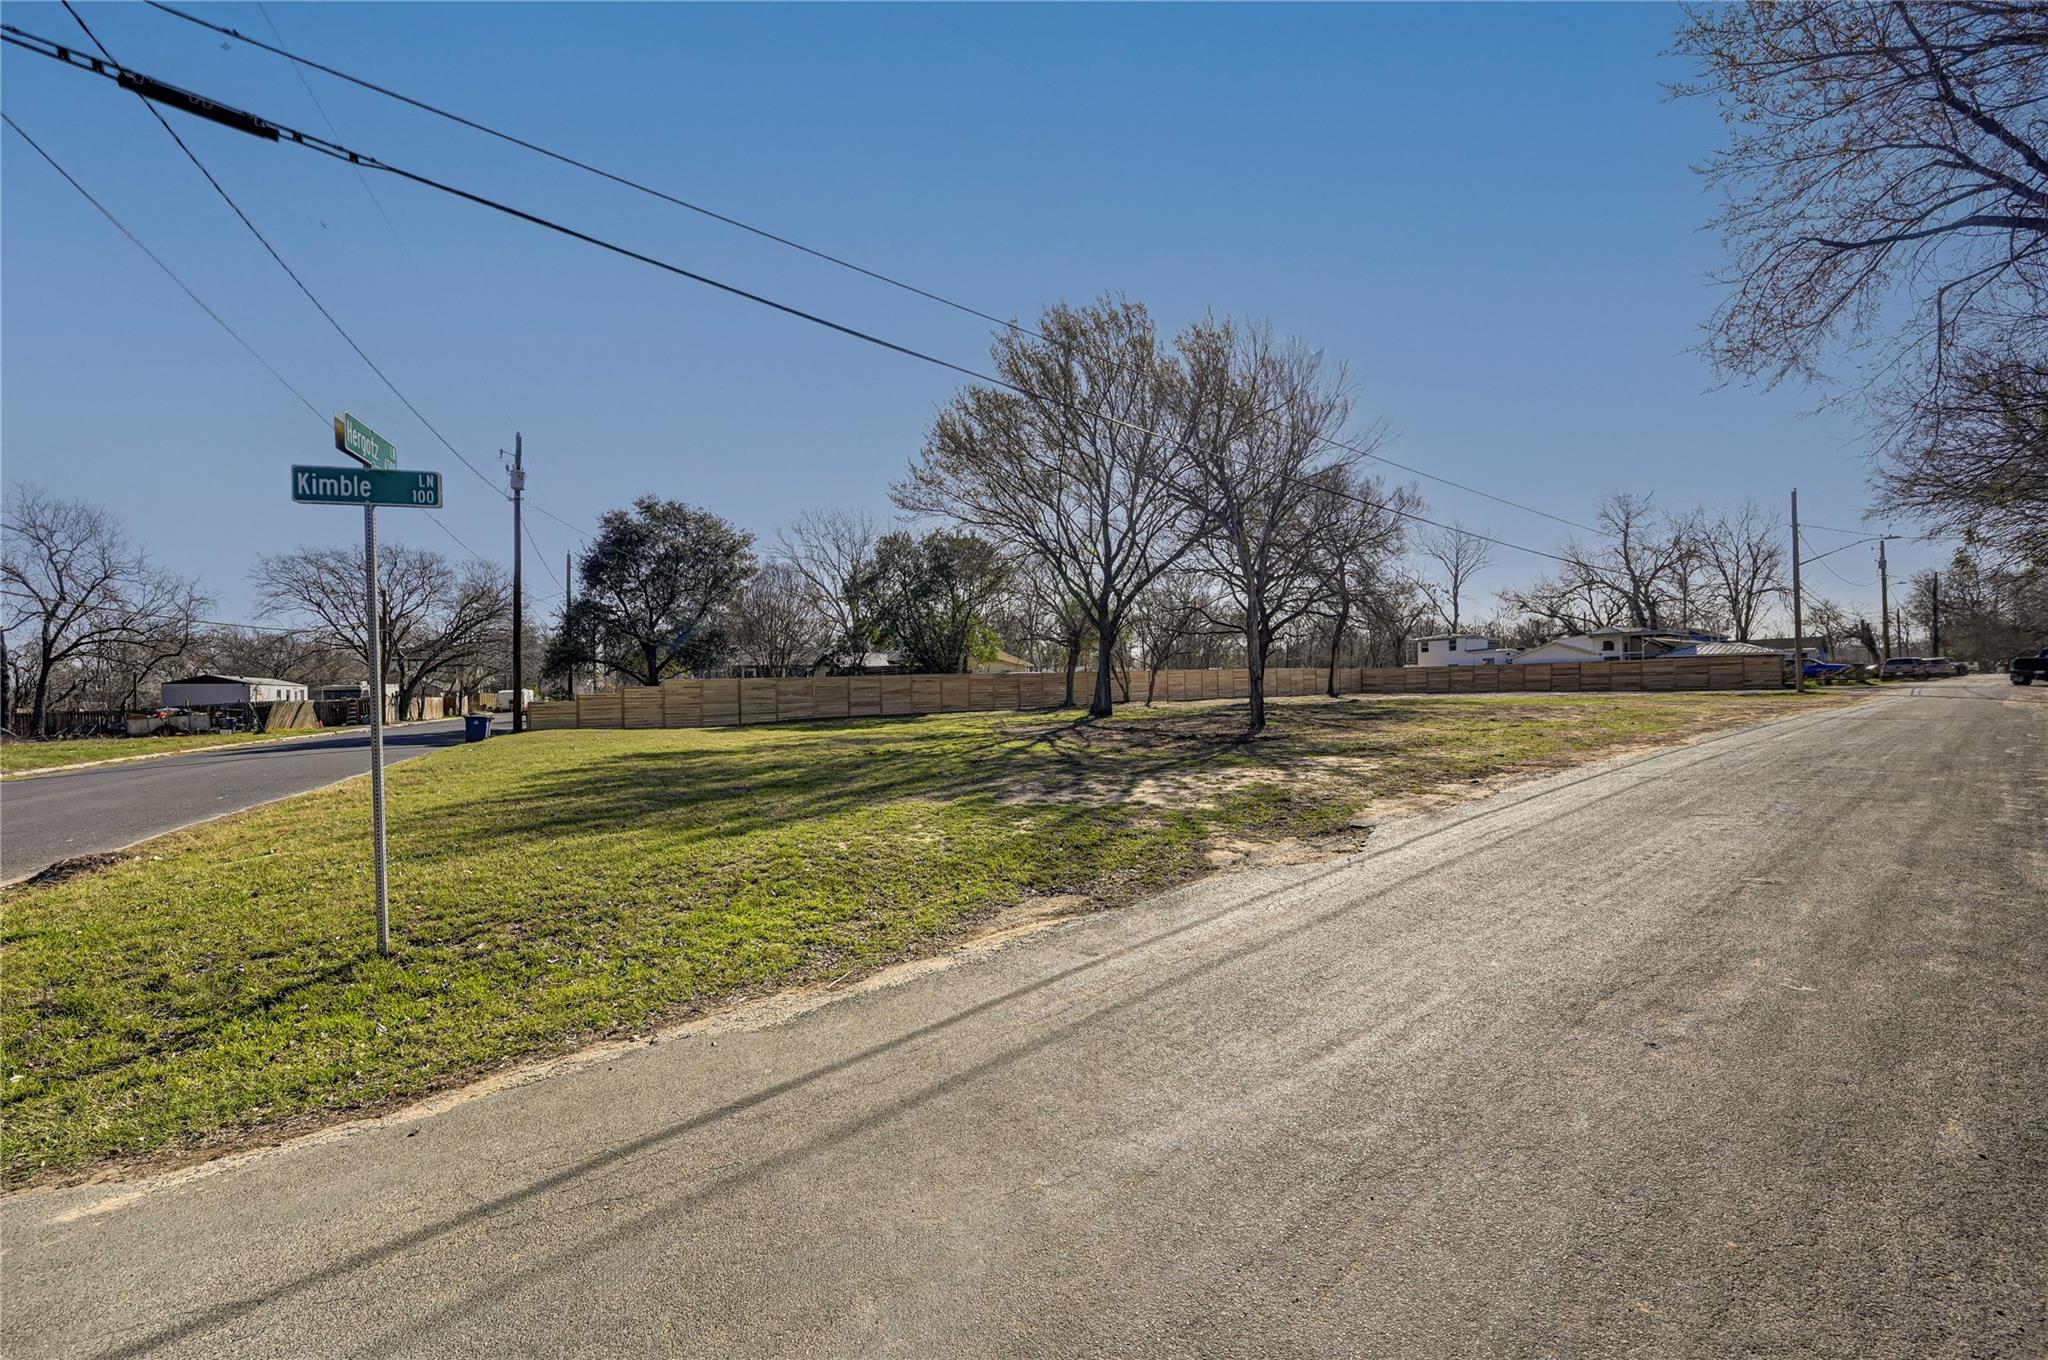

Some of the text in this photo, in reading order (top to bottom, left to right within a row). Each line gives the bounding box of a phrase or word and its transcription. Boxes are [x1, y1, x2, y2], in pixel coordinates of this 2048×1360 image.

[346, 419, 379, 461] Hergotz
[297, 472, 435, 498] Kimble LN
[413, 489, 435, 504] 100
